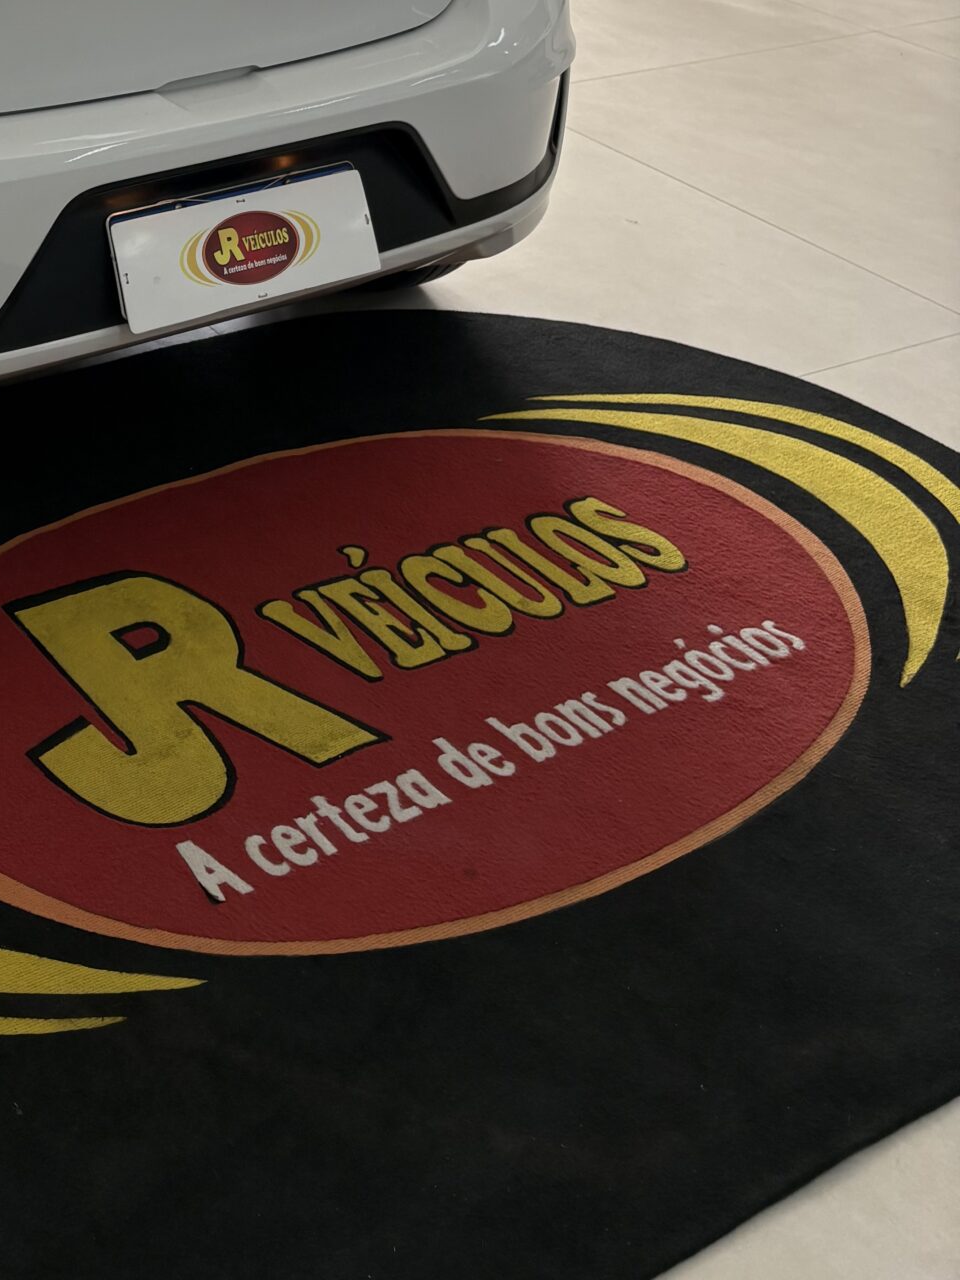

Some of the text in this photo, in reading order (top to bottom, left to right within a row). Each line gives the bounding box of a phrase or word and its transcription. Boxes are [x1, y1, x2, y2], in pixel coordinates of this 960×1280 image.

[213, 227, 290, 266] JR VEÍCULOS
[223, 266, 229, 276] A
[247, 261, 254, 270] de
[254, 259, 267, 269] bons
[8, 572, 389, 828] JR
[175, 619, 807, 903] A certeza de bons negócios
